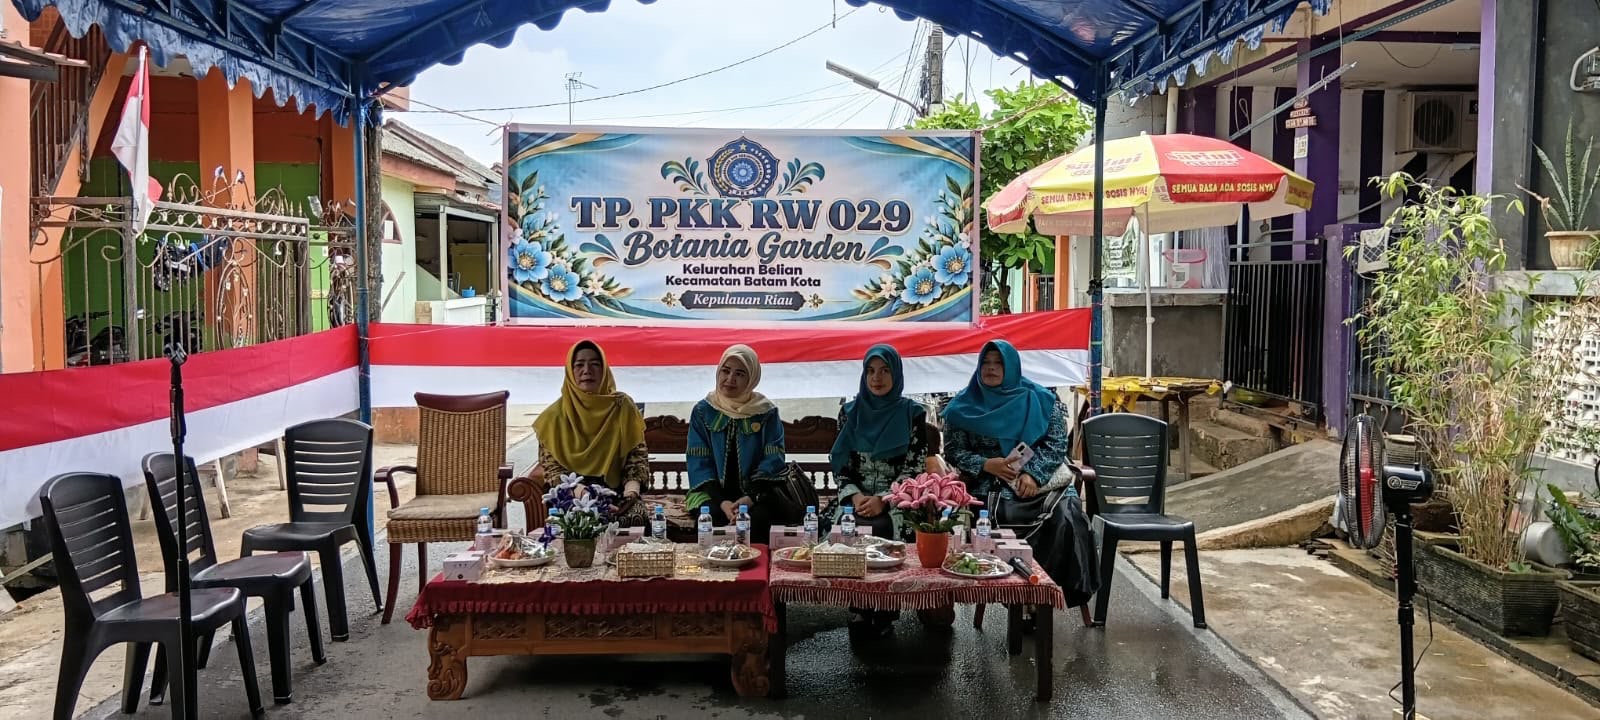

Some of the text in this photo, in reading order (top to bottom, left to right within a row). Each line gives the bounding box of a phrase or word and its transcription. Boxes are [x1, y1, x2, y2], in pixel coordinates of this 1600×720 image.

[1041, 193, 1066, 205] SEMUA
[1067, 192, 1087, 203] RASA
[1105, 188, 1128, 199] SOSIS
[1129, 186, 1148, 197] NYA!
[1171, 183, 1197, 194] SEMUA
[1199, 183, 1218, 193] RASA
[1220, 183, 1235, 193] ADA
[1236, 183, 1257, 193] SOSIS
[1259, 183, 1276, 193] NYA!
[570, 196, 912, 232] TP. PKK RW 029
[623, 230, 866, 266] Botania Garden
[683, 263, 803, 276] Kelurahan Belian
[665, 275, 821, 287] Kecamatan Batam Kota
[692, 293, 794, 307] Kepulauan Riau
